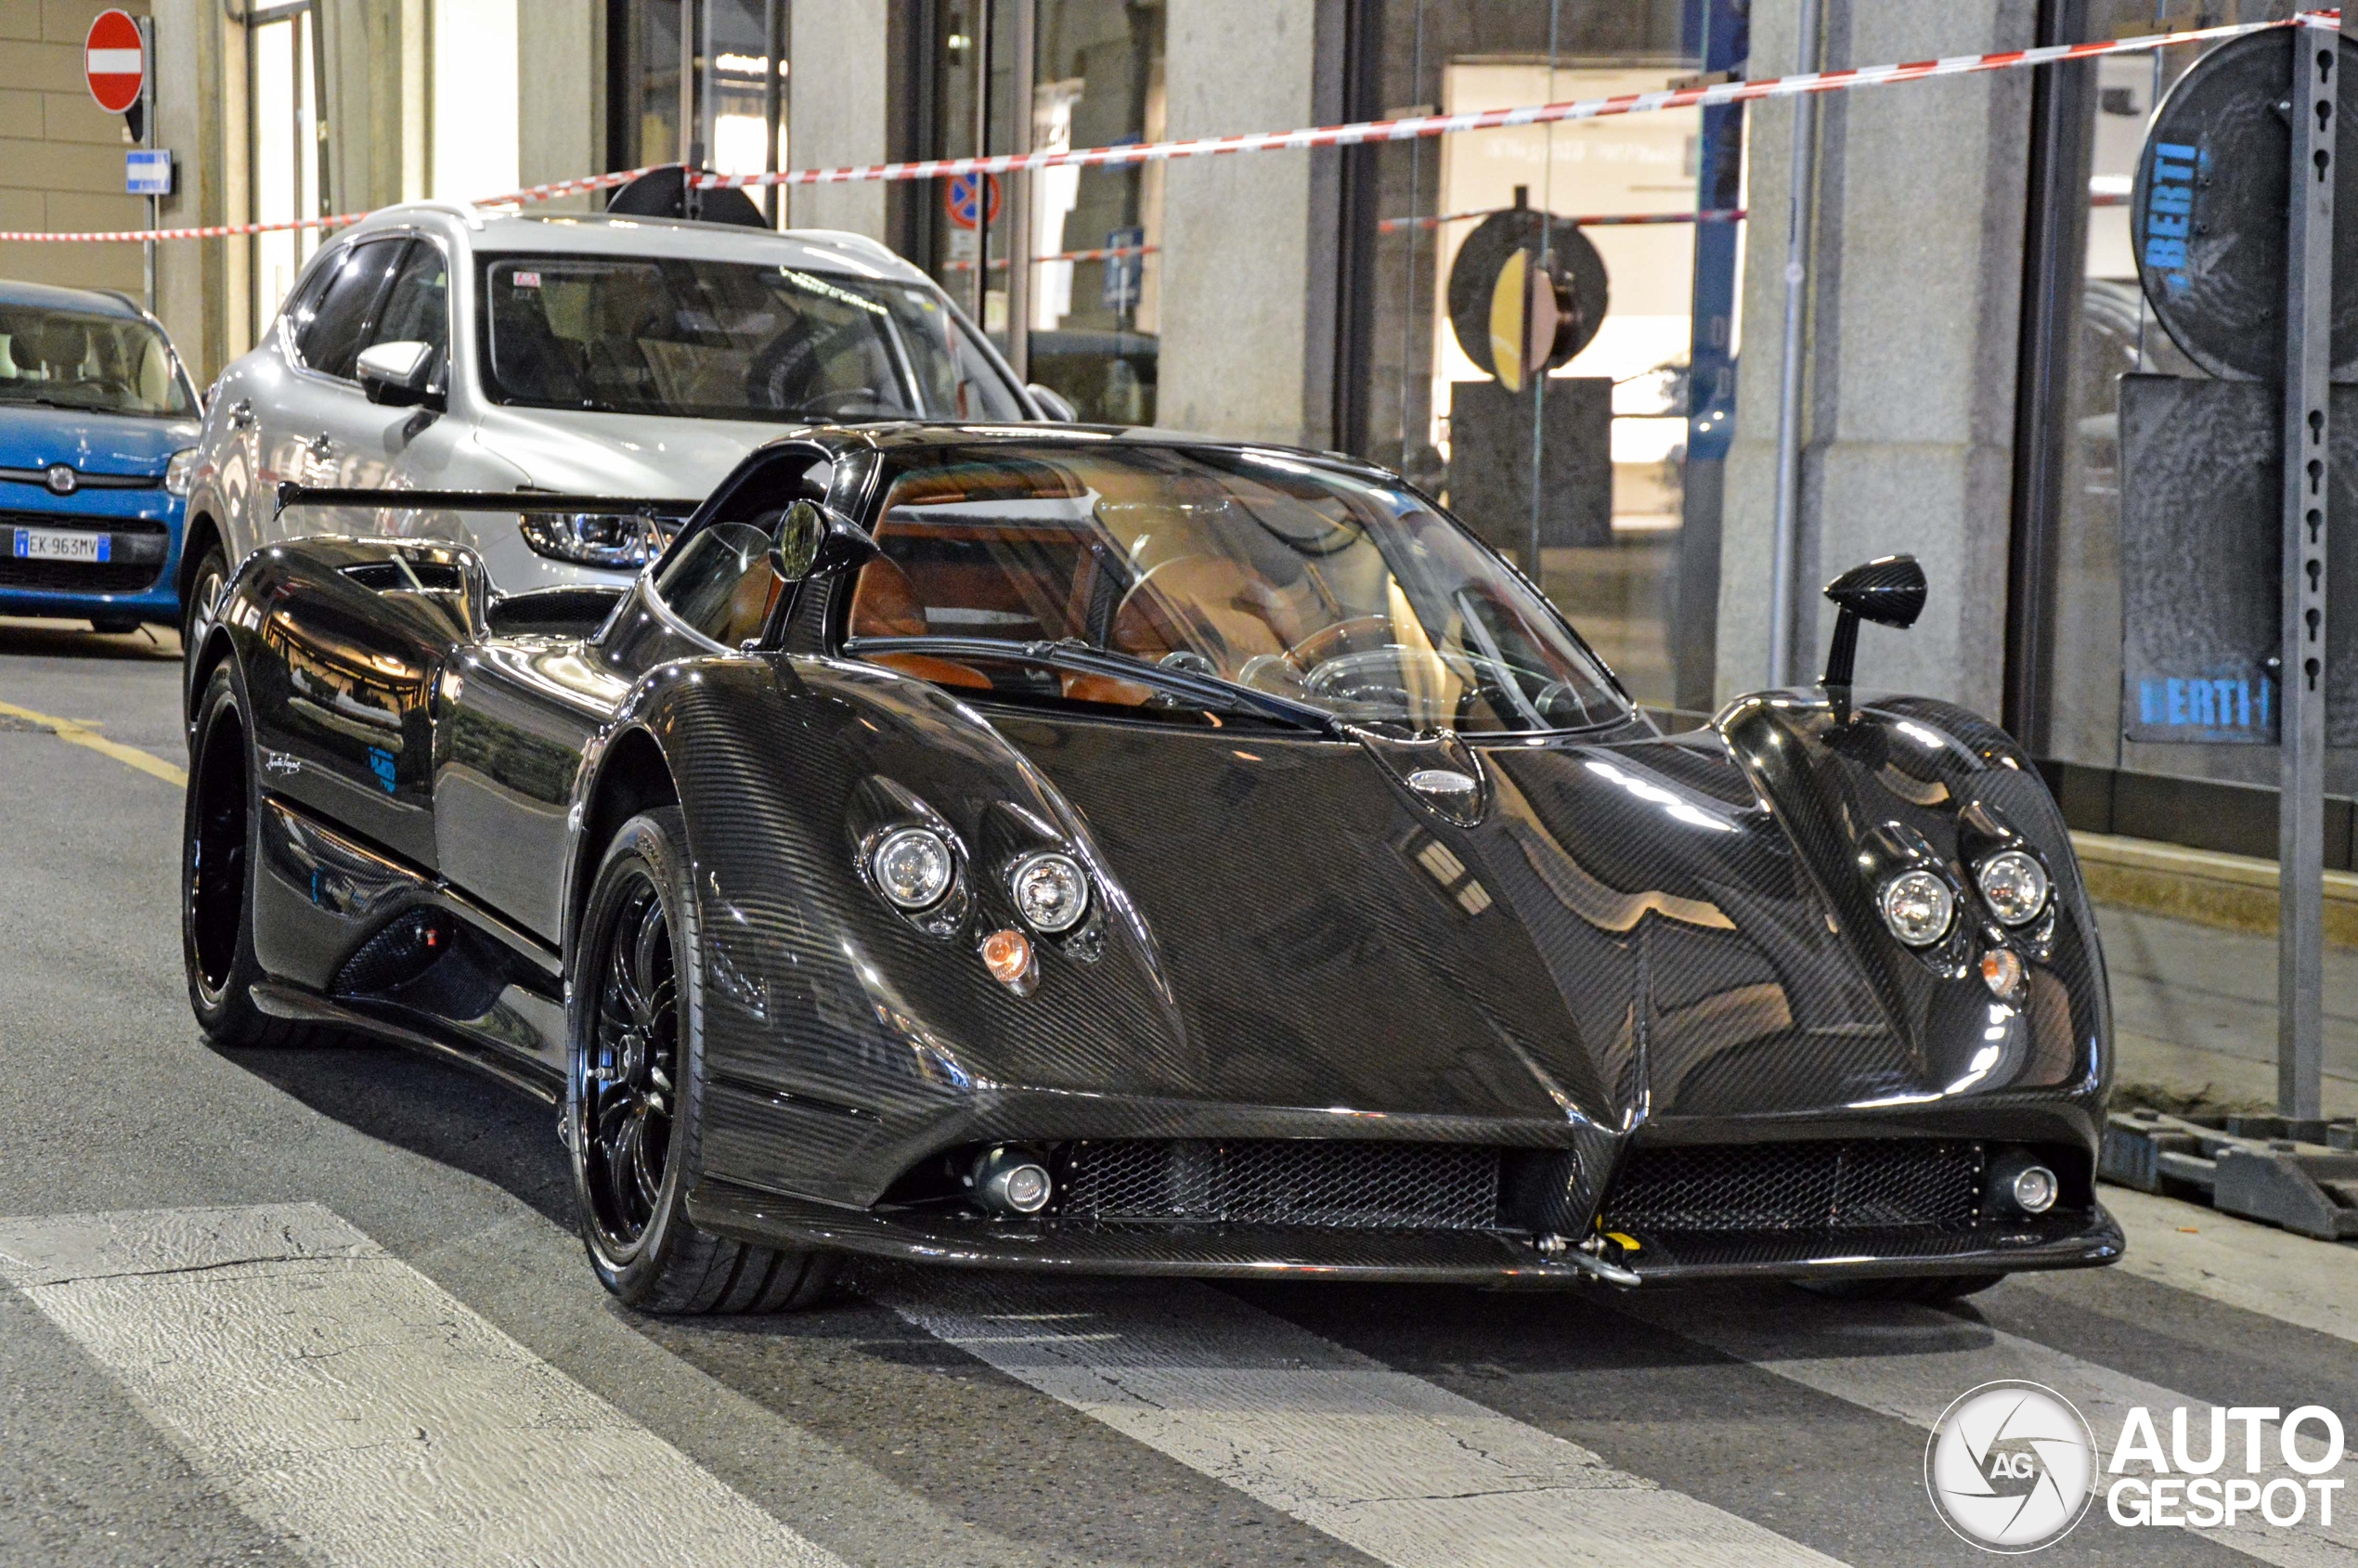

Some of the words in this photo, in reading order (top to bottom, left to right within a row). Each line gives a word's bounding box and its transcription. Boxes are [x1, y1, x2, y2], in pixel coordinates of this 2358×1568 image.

[2144, 143, 2196, 268] BERTI
[29, 536, 46, 553] EK
[52, 538, 97, 555] 963MV
